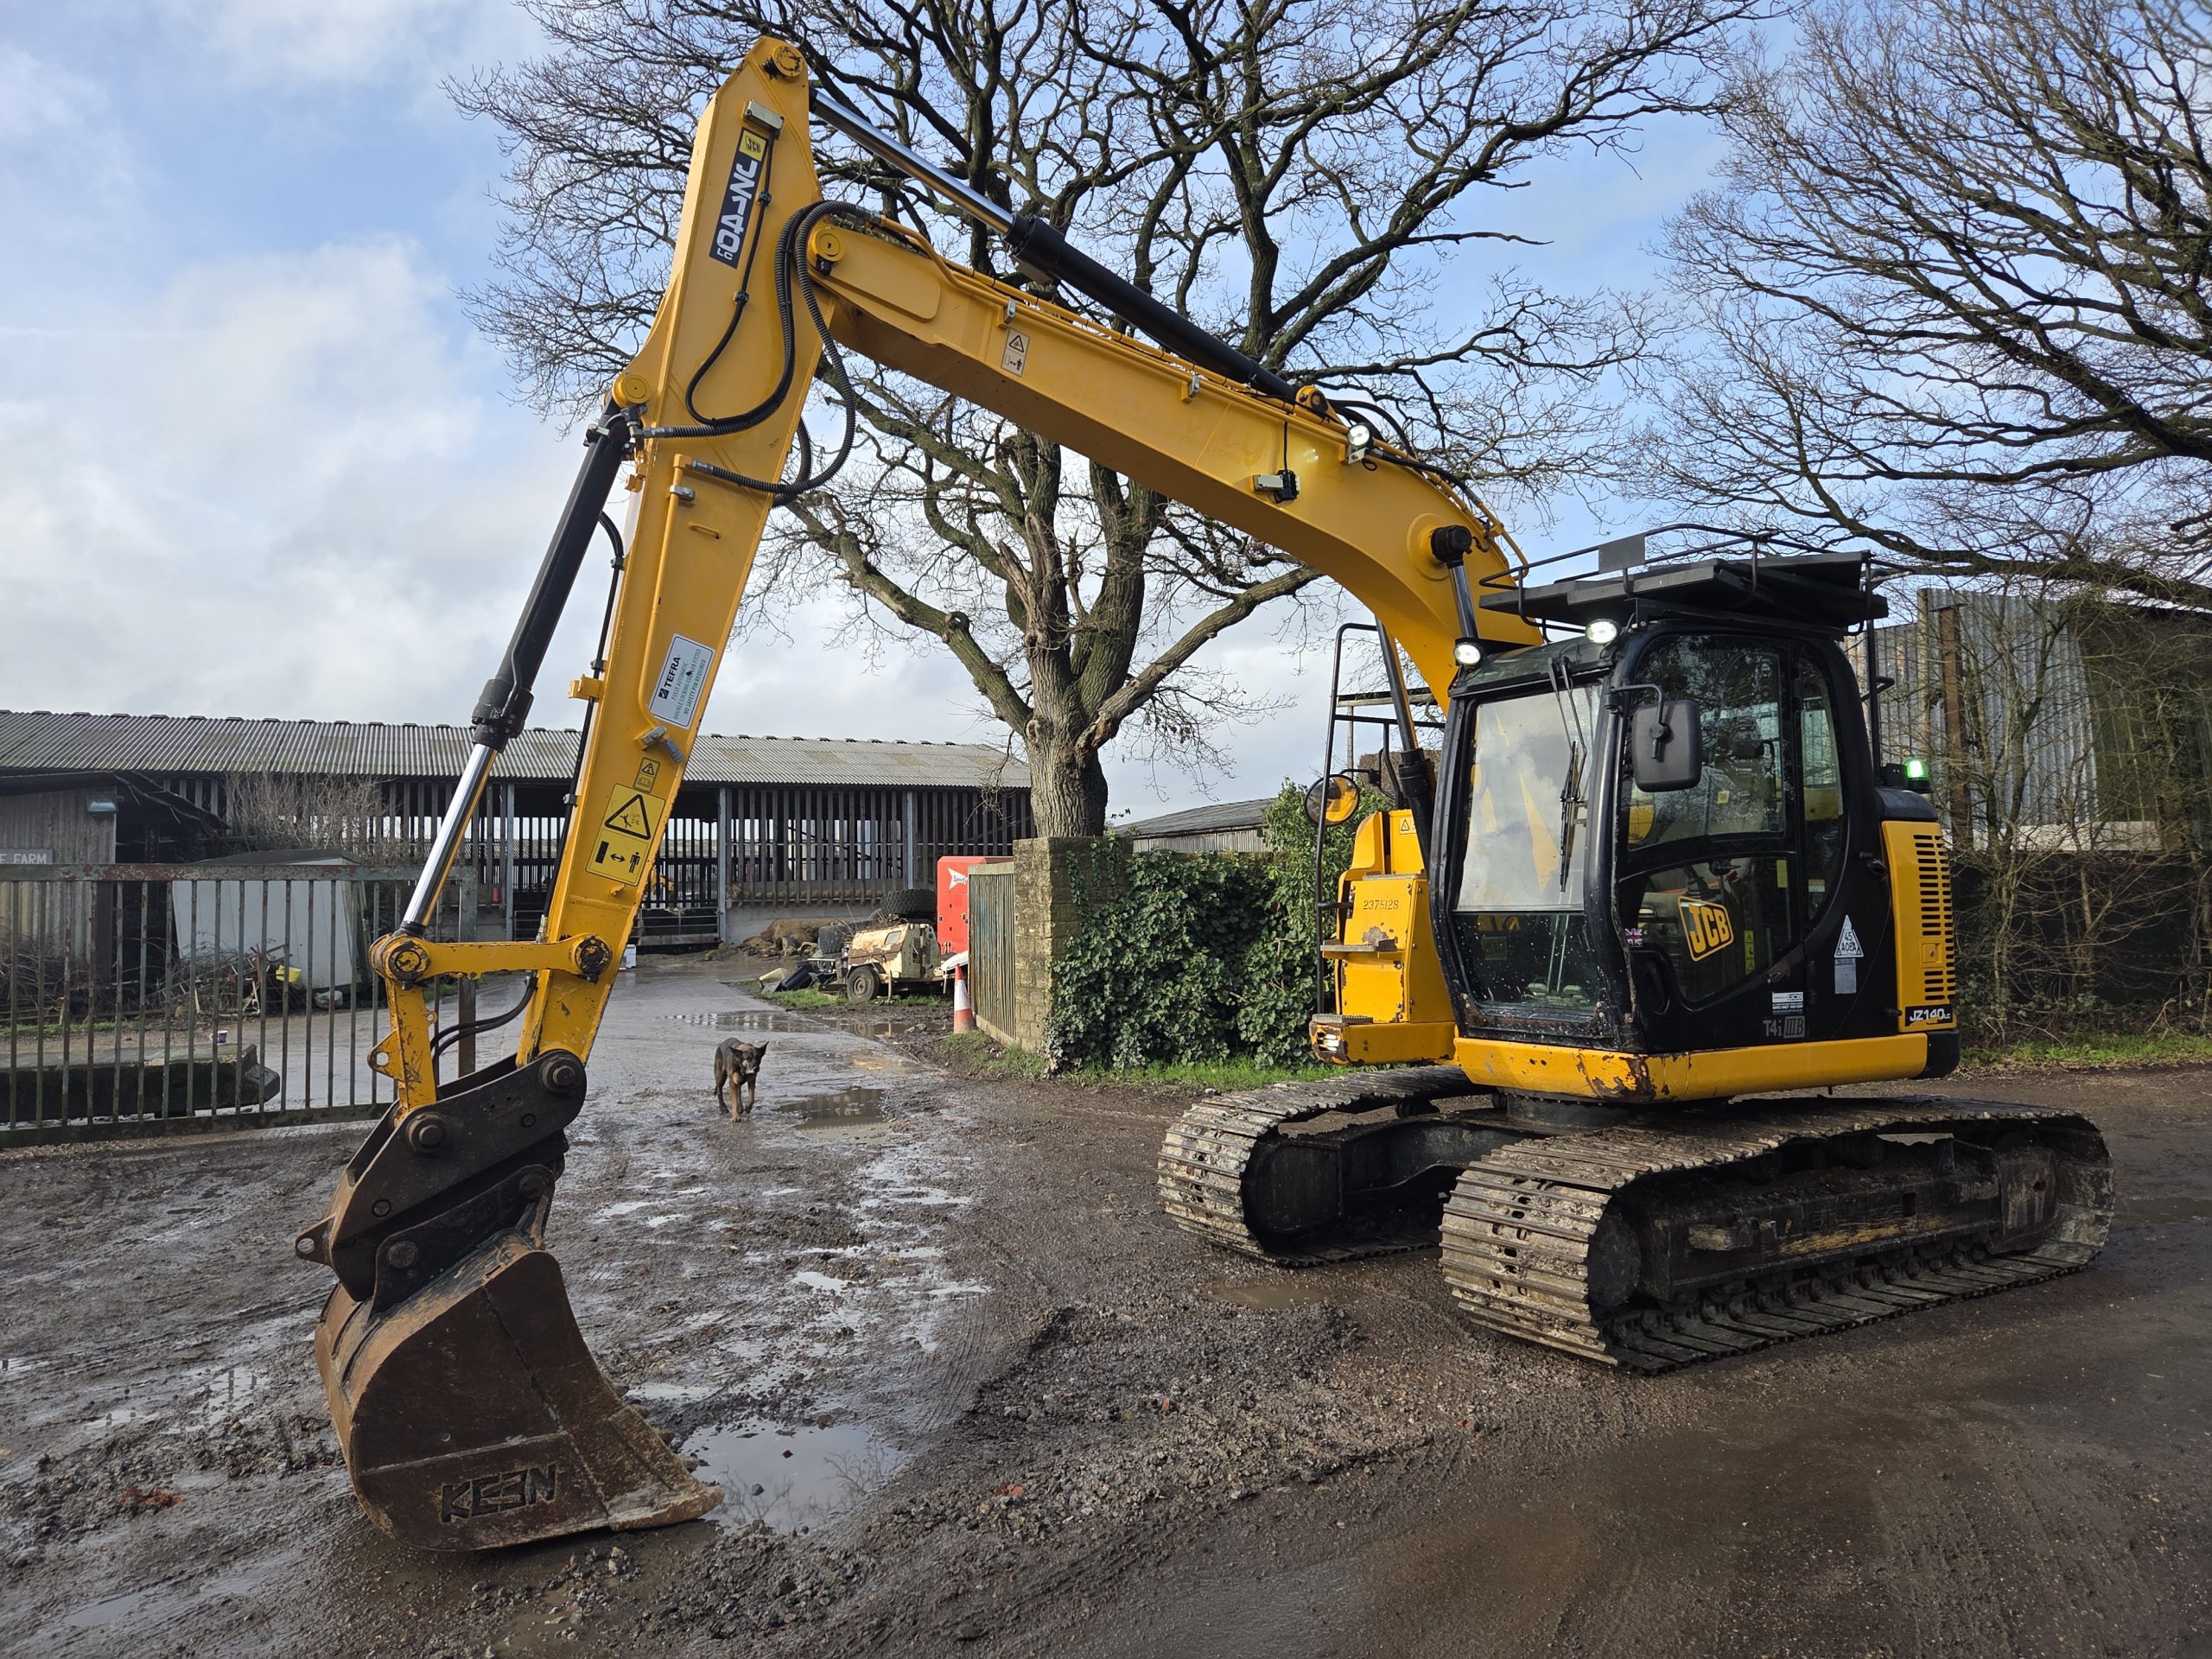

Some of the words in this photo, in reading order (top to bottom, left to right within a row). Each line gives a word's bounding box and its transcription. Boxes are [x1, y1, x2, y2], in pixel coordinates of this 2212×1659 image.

[747, 138, 761, 153] JCB
[716, 160, 758, 254] JZ140
[716, 248, 734, 261] LC
[664, 657, 681, 688] TEFRA
[671, 686, 680, 701] FULLY
[676, 662, 689, 687] AUTOMATIC
[695, 659, 707, 683] REQUIRED
[673, 701, 683, 720] DOUBLE
[679, 683, 690, 702] LOCKING
[692, 649, 702, 664] FITTED
[686, 690, 696, 708] SAFETY
[683, 707, 690, 715] NO
[13, 853, 47, 865] FARM
[1688, 904, 1730, 954] JCB
[1909, 1007, 1945, 1021] JZ140
[1763, 1019, 1783, 1037] T4i
[442, 1461, 557, 1523] KEEN
